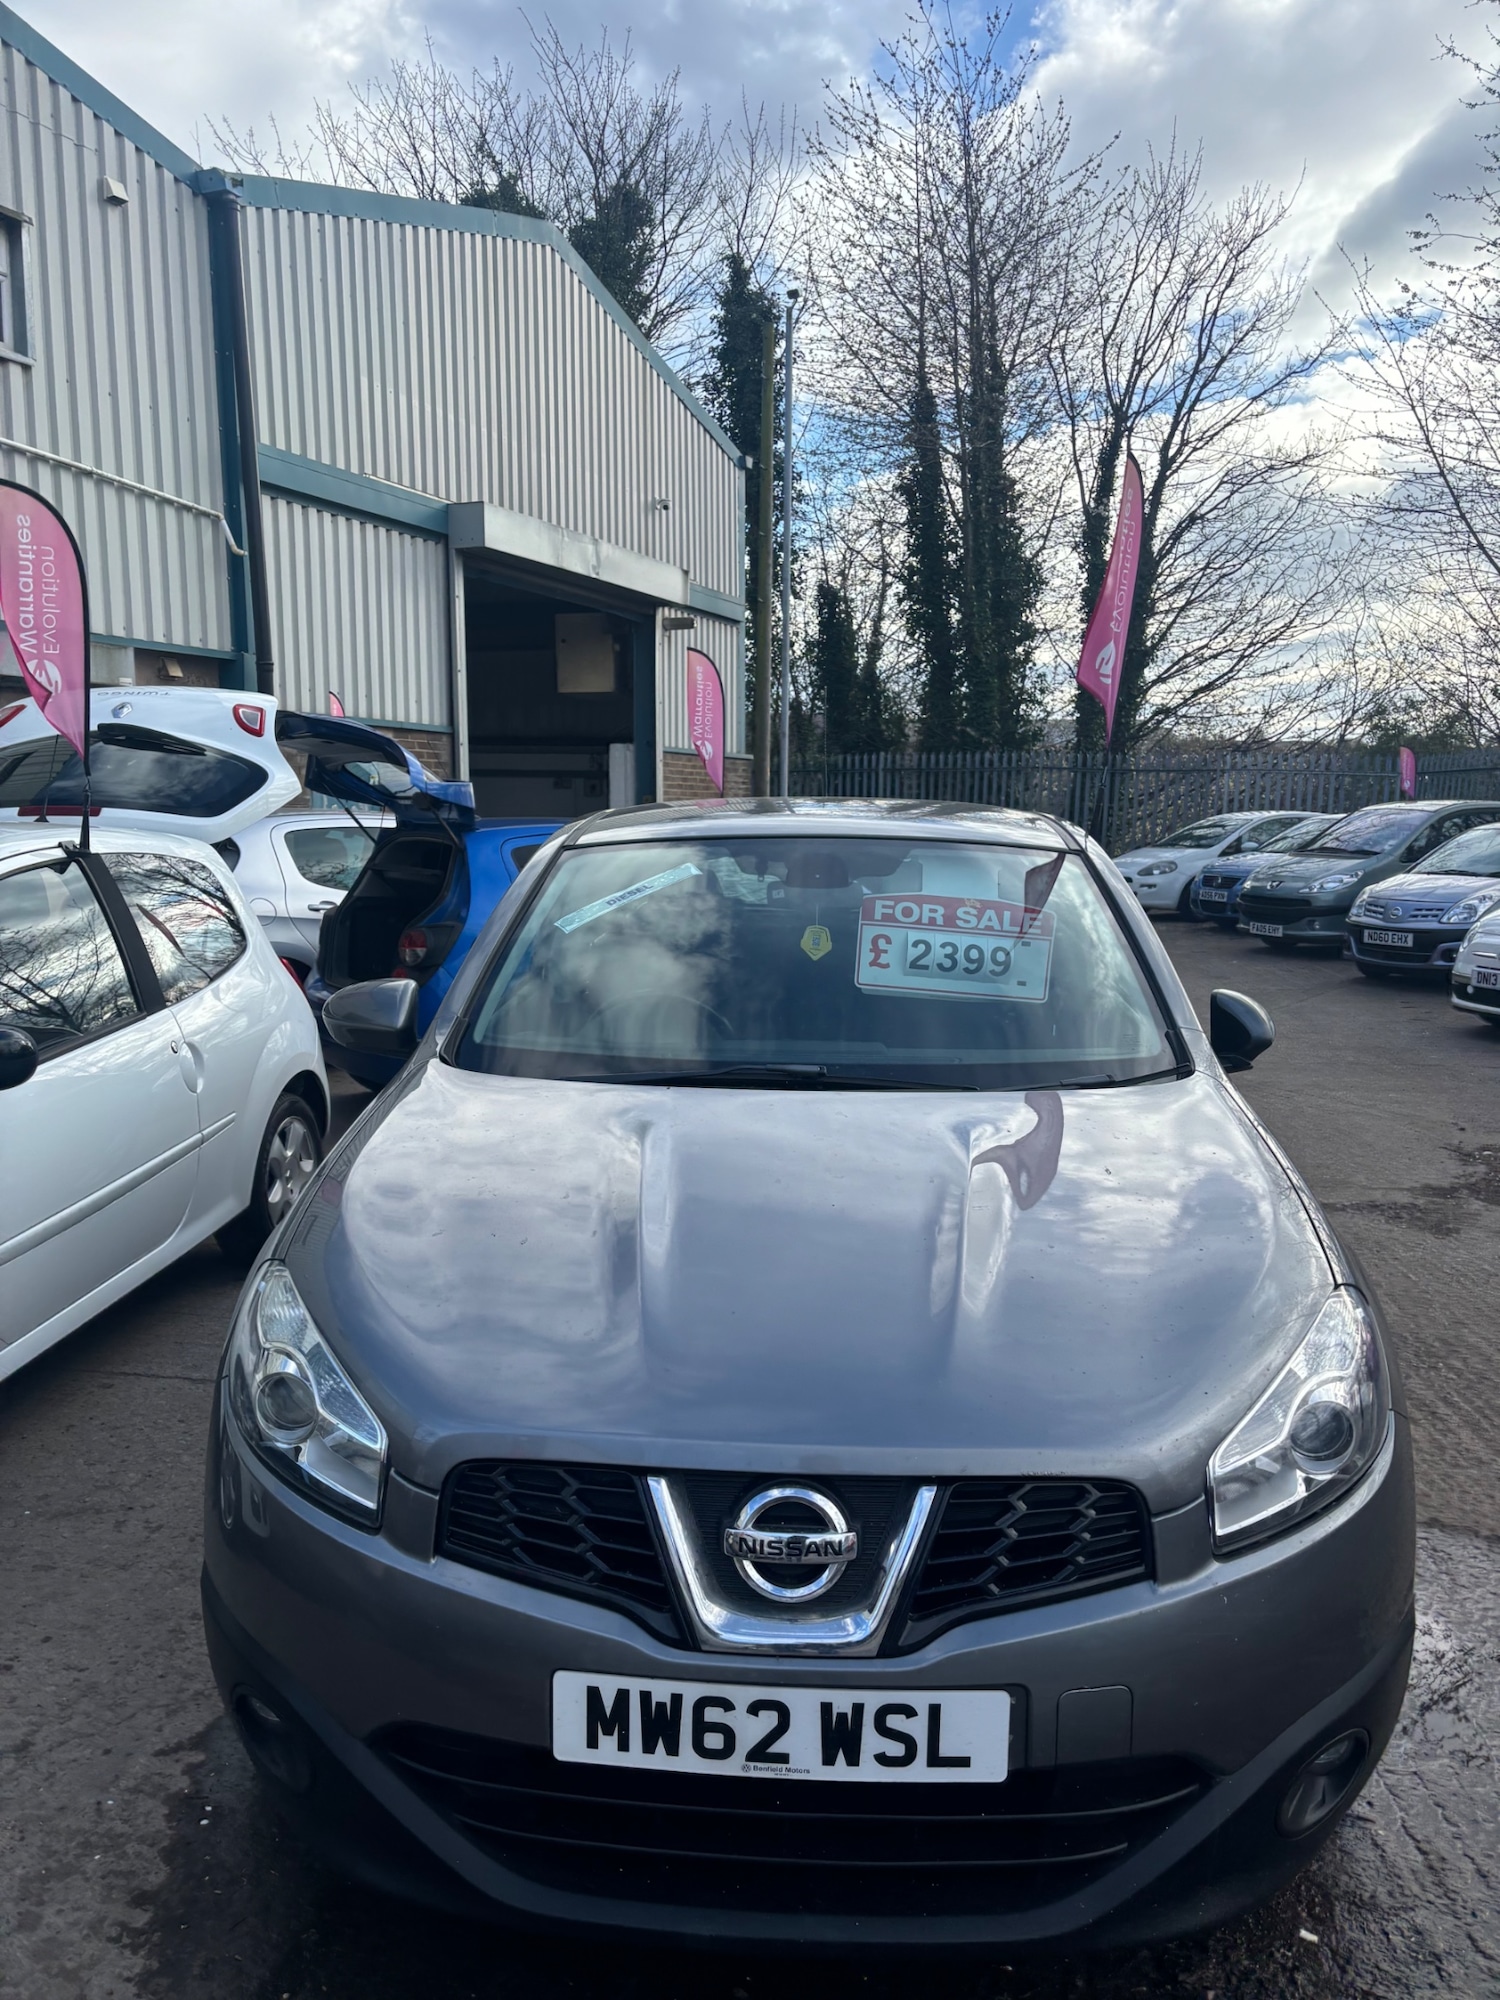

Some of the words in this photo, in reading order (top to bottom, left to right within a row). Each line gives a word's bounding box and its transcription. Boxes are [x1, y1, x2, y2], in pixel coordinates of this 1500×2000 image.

[605, 884, 654, 906] DIESEL
[874, 900, 945, 926] FOR
[955, 908, 1044, 935] SALE
[1367, 931, 1389, 943] ND60
[1392, 933, 1409, 945] EHX
[908, 939, 1012, 977] 2399
[1477, 972, 1498, 987] DN13
[738, 1537, 843, 1557] NISSAN
[586, 1685, 790, 1764] MW62
[820, 1701, 971, 1768] WSL
[753, 1765, 783, 1773] Benfield
[785, 1767, 810, 1775] Motors
